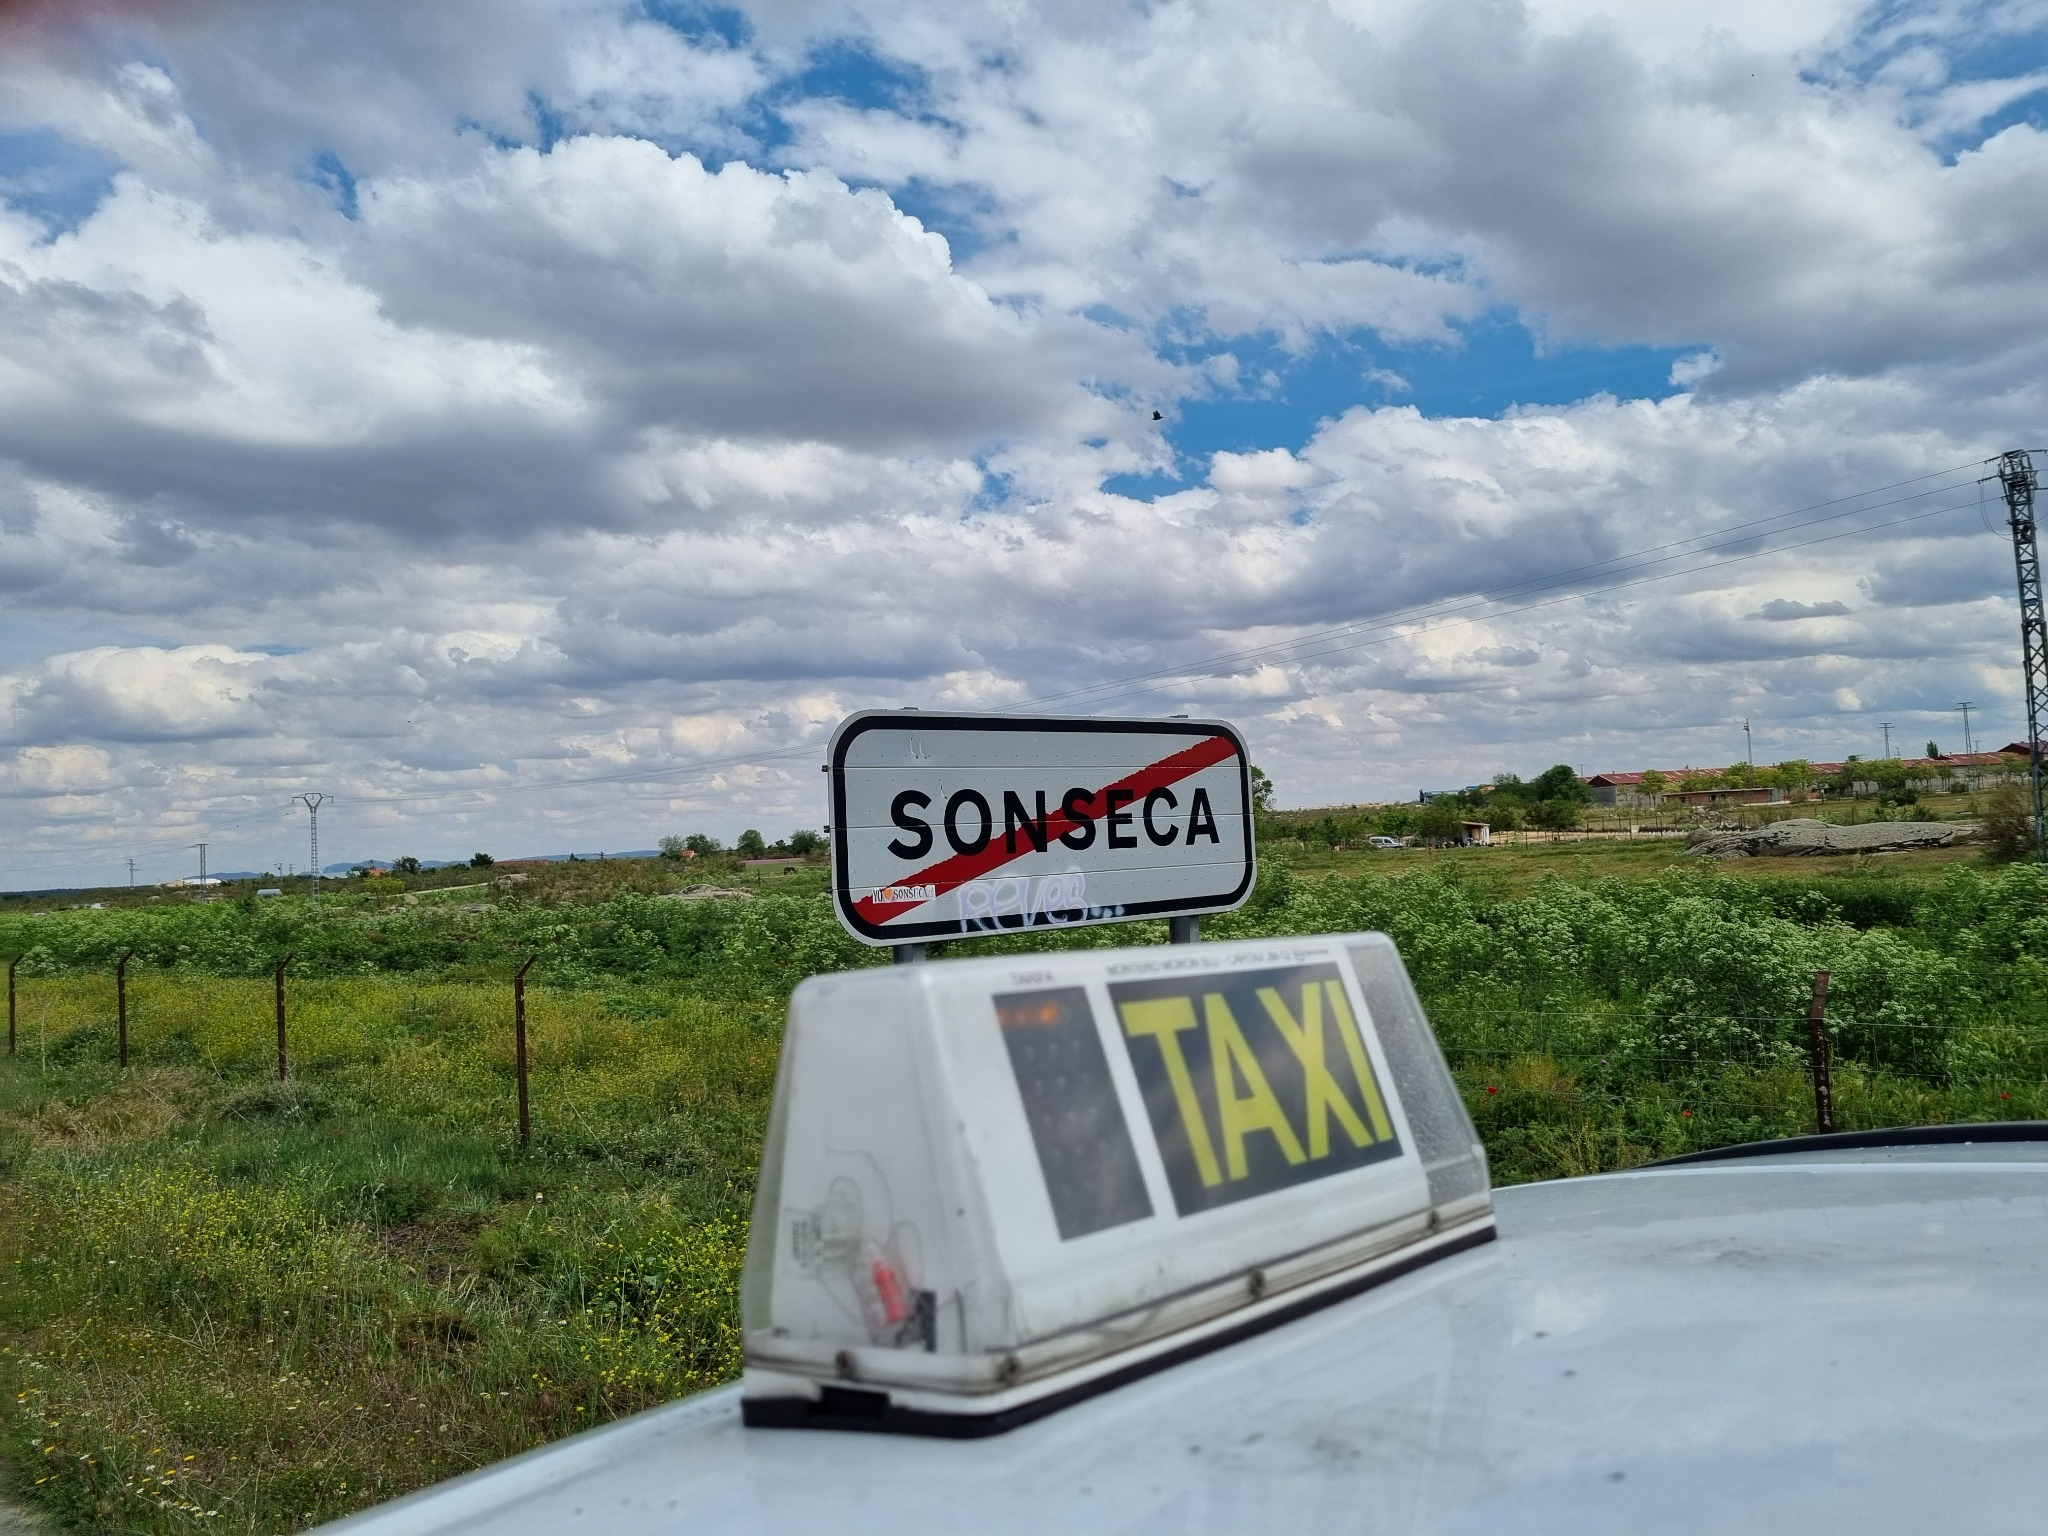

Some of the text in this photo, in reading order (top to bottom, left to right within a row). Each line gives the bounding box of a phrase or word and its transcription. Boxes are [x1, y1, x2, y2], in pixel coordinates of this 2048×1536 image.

[887, 787, 1220, 860] SONSECA
[872, 889, 883, 902] YO
[1120, 979, 1394, 1188] TAXI
